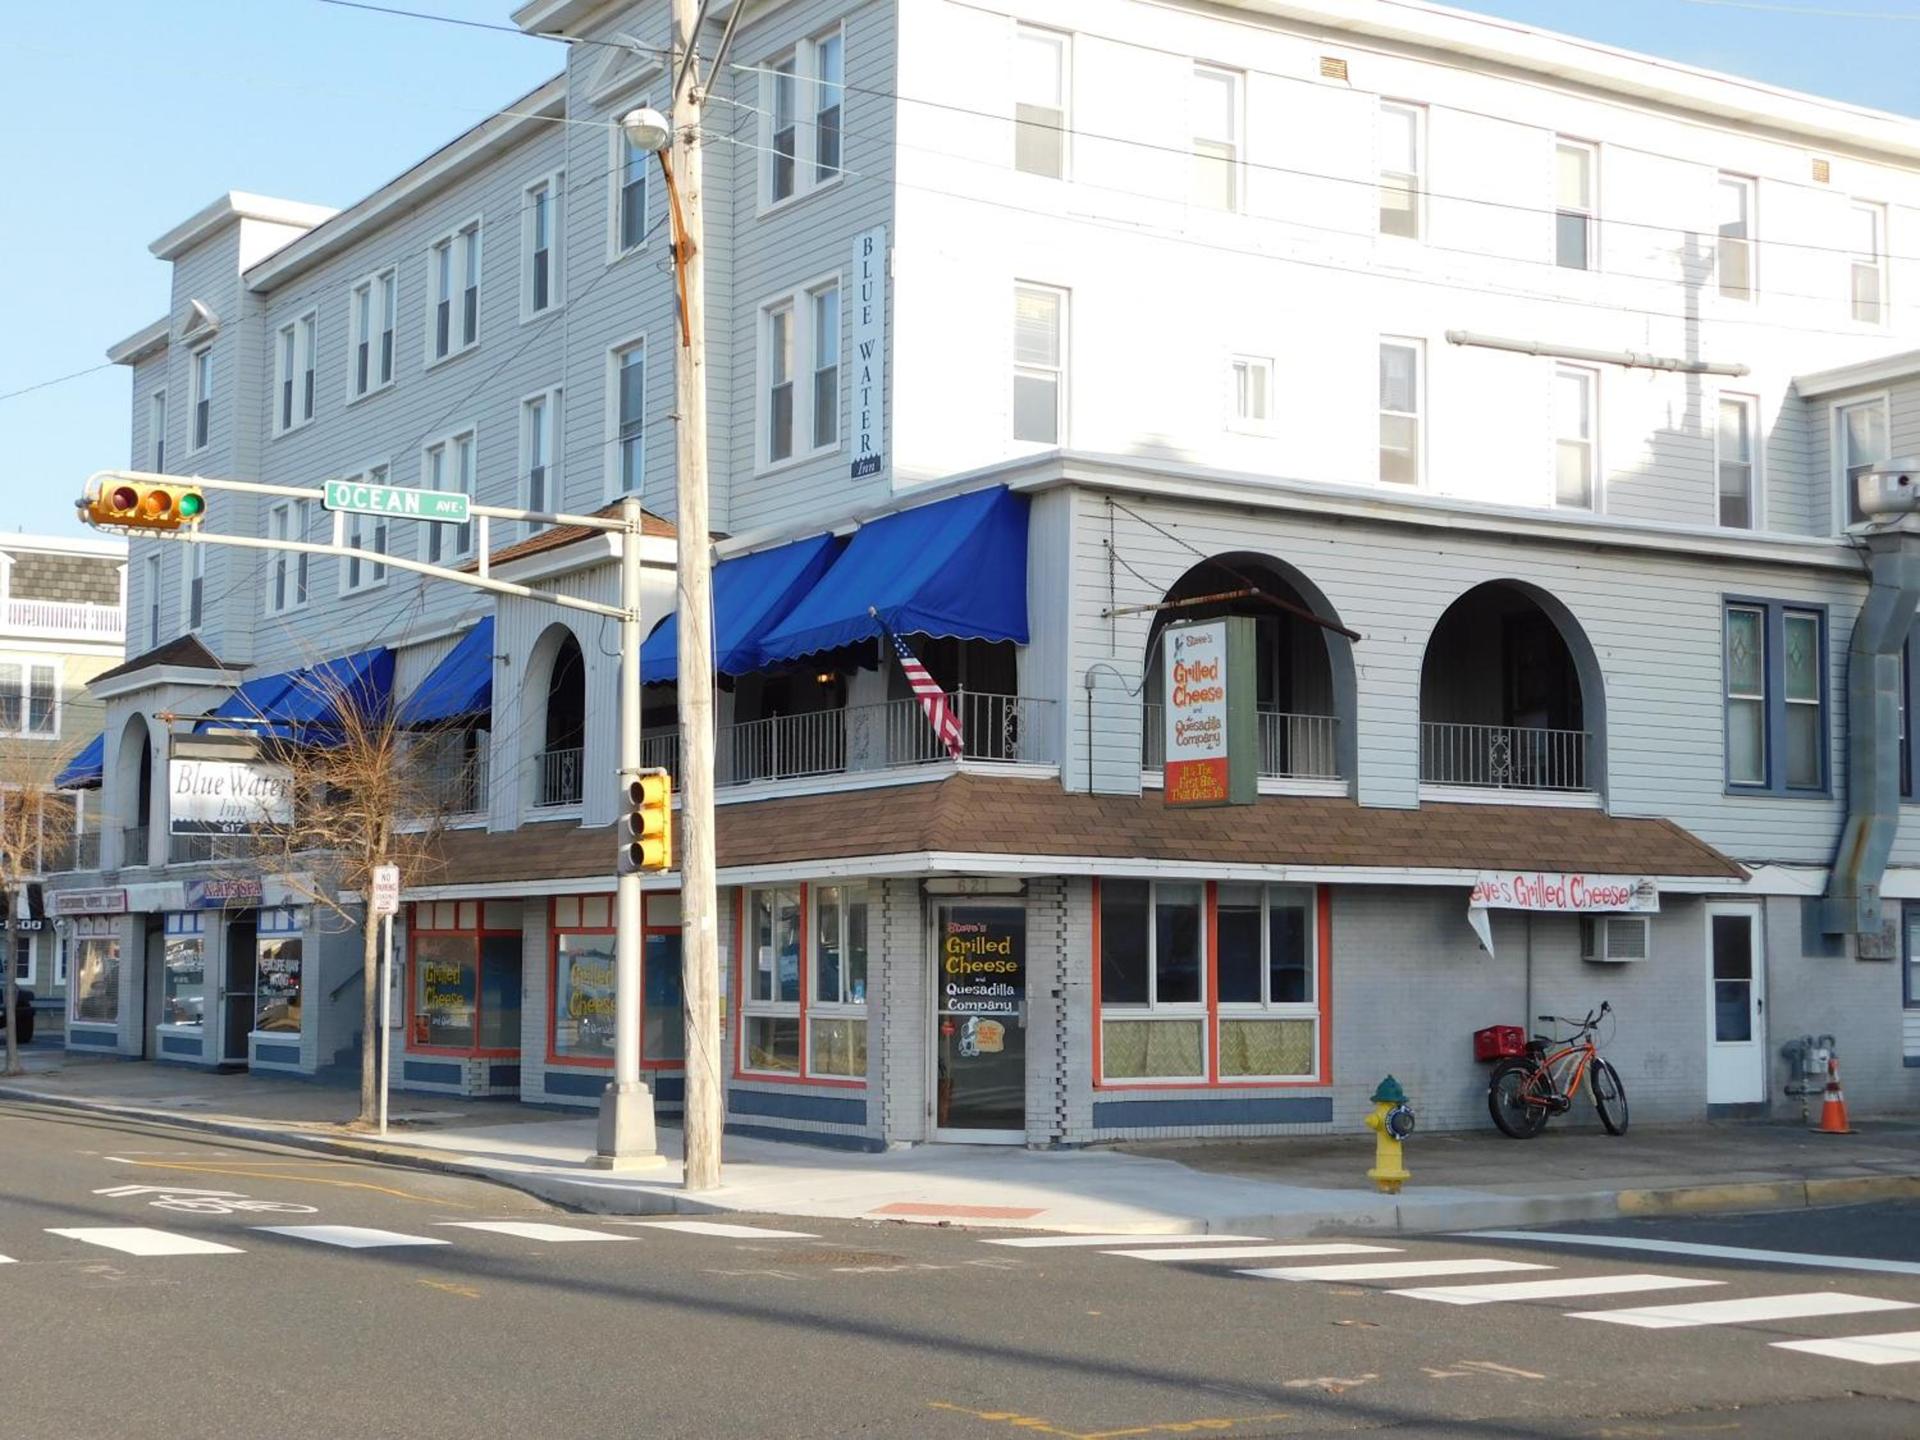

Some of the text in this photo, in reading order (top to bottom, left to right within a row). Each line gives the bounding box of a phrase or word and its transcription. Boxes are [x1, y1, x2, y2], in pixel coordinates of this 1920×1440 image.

[859, 236, 875, 453] BLUE WATER
[857, 461, 875, 475] Inn
[335, 485, 420, 514] OCEAN
[1173, 656, 1218, 683] Grilled
[1173, 685, 1223, 707] Cheese
[1175, 717, 1221, 734] Quesadilla
[1176, 732, 1221, 747] Company
[176, 763, 291, 797] Blue Water
[219, 799, 247, 817] Inn
[222, 823, 244, 833] 617
[382, 873, 391, 881] NO
[957, 879, 989, 893] 621
[1514, 875, 1566, 908] Grilled
[1569, 876, 1630, 908] Cheese
[948, 922, 986, 933] Steve's
[946, 936, 1010, 955] Grilled
[425, 961, 461, 985] Grilled
[945, 957, 1018, 974] Cheese
[571, 962, 616, 988] Grilled
[425, 987, 465, 1009] Cheese
[946, 983, 1015, 996] Quesadilla
[948, 998, 1012, 1013] Company
